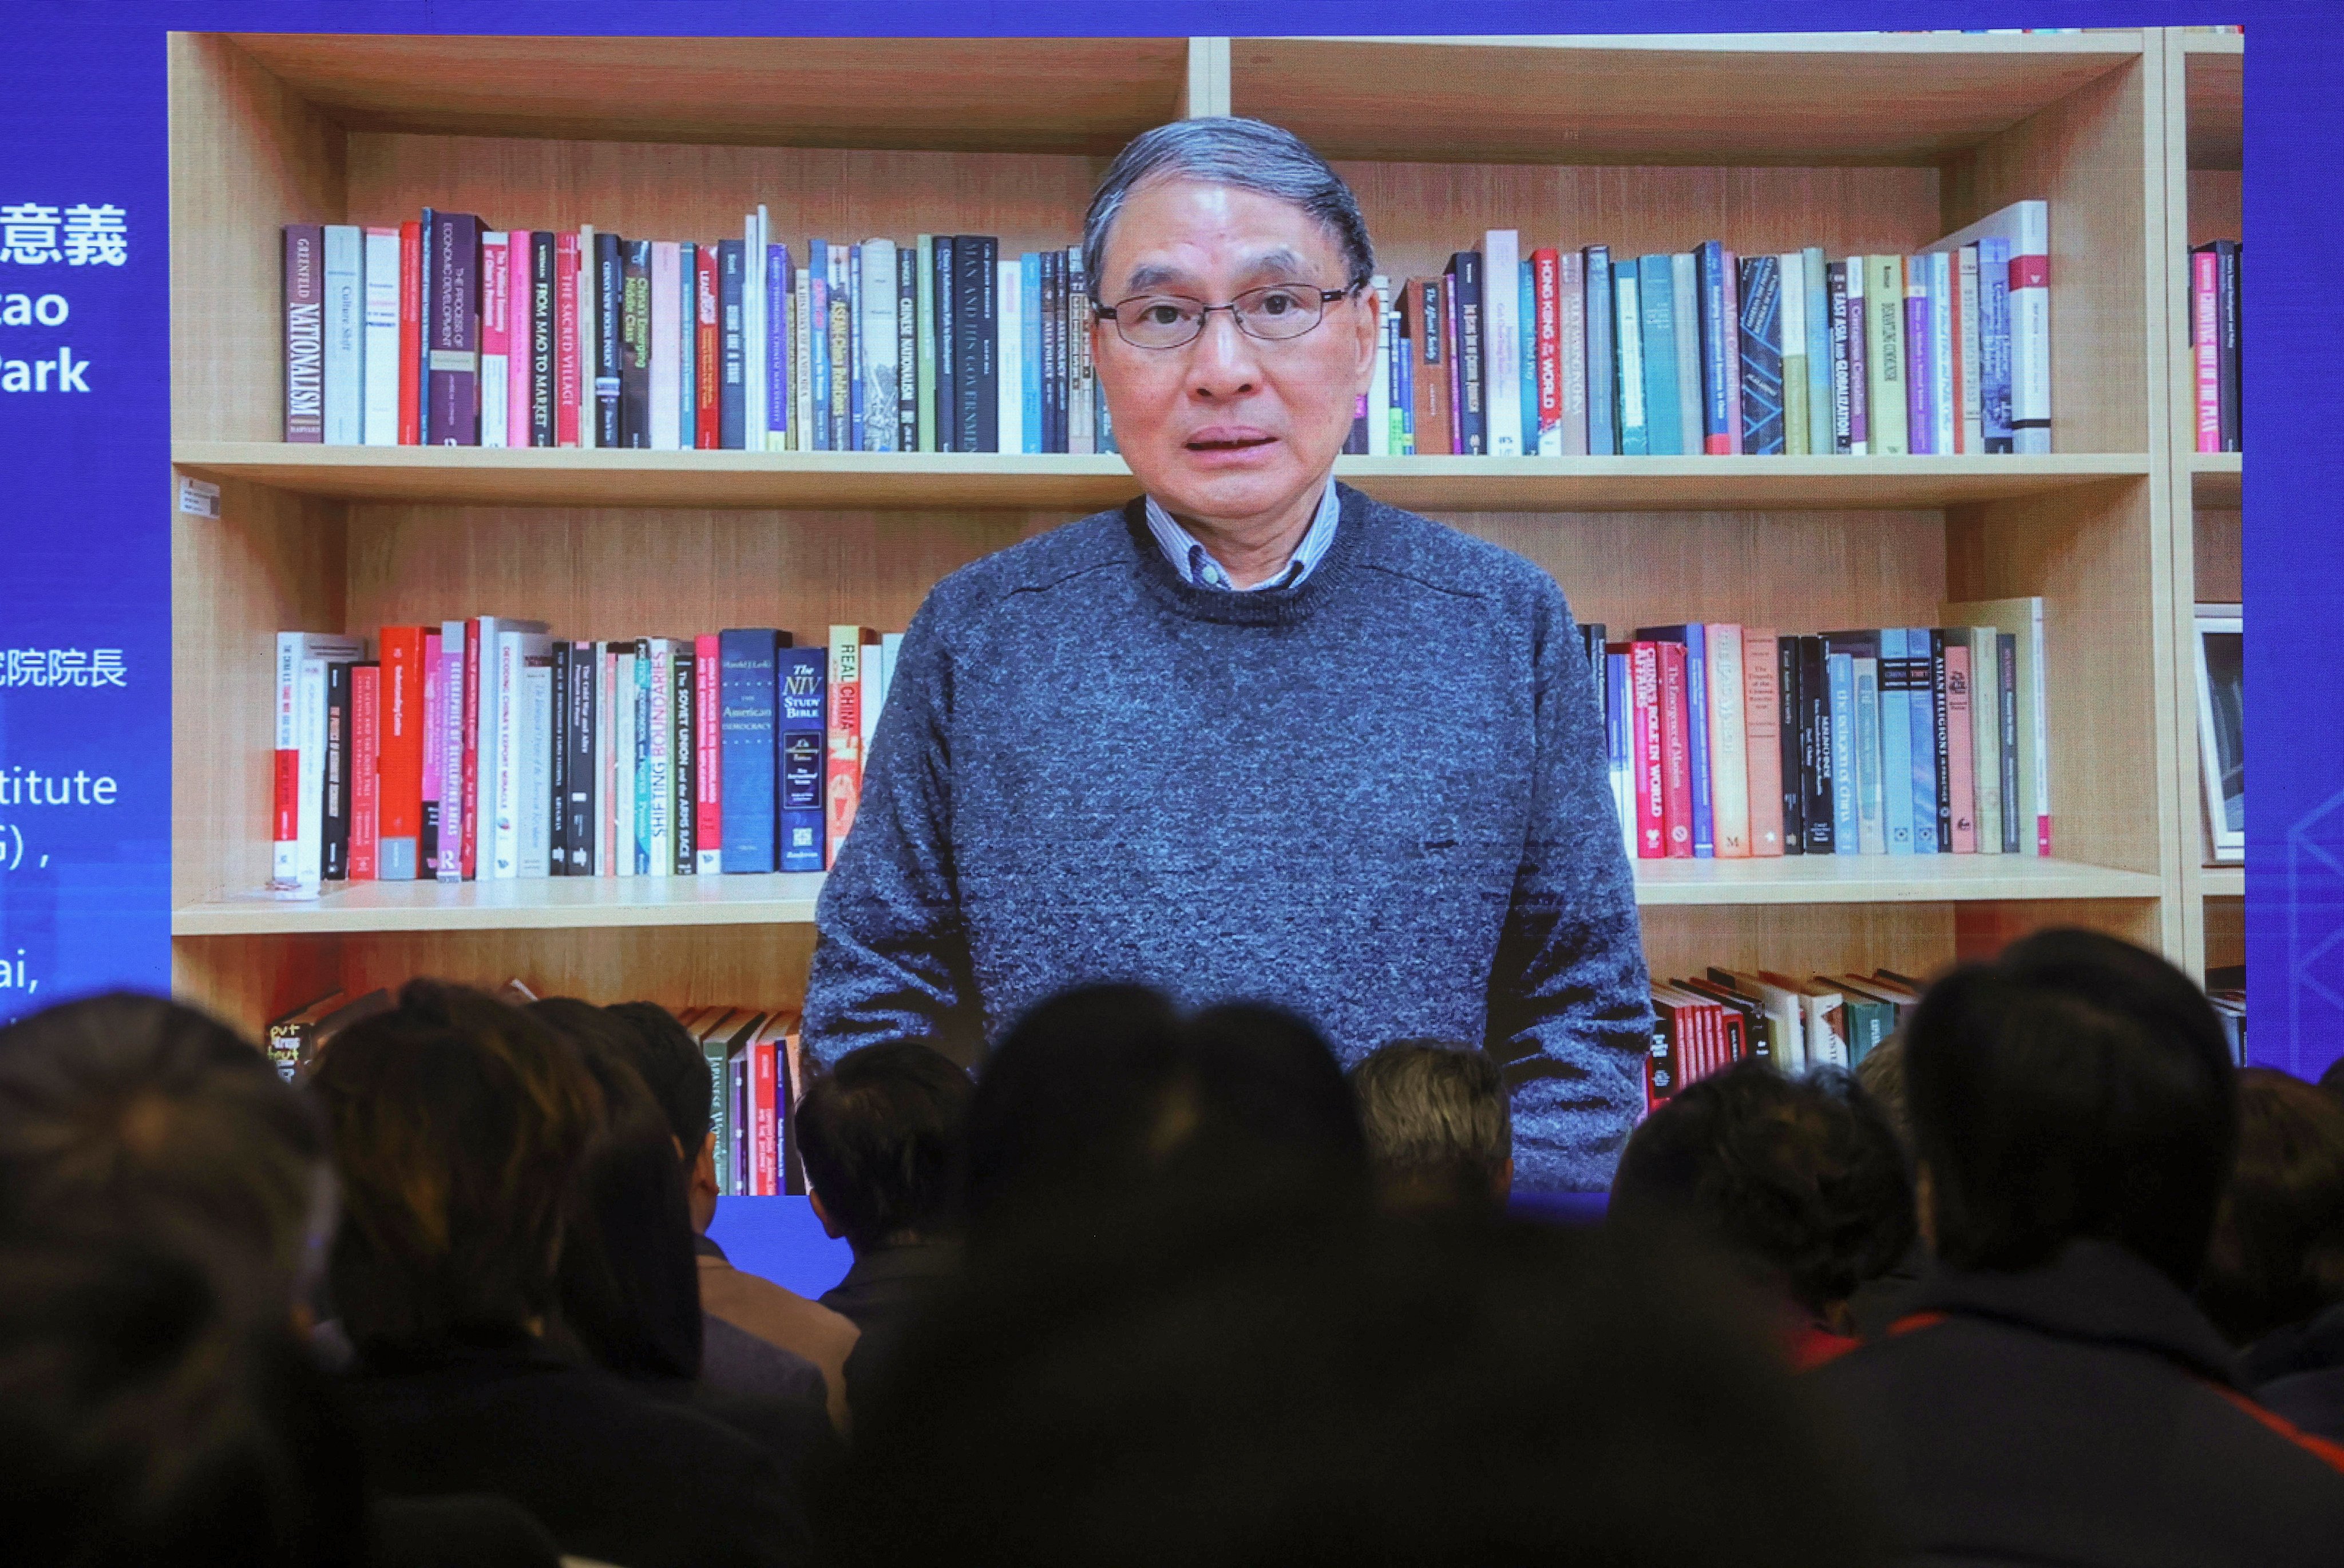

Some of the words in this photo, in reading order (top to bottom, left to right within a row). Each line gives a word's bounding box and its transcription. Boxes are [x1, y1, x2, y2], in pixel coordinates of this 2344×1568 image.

[0, 203, 127, 266] 意義
[441, 222, 452, 275] ECONOMIC
[296, 238, 310, 298] GREENFELD
[964, 243, 977, 278] MAN
[562, 275, 573, 298] THE
[625, 276, 636, 312] Middle
[1426, 287, 1437, 302] The
[1542, 260, 1553, 298] HONG
[0, 293, 69, 326] ao
[441, 276, 452, 347] DEVELOPMENT
[536, 283, 548, 316] FROM
[638, 277, 648, 315] China's
[964, 285, 977, 318] AND
[1834, 292, 1846, 317] EAST
[562, 302, 573, 353] SACRED
[625, 314, 635, 342] Class
[901, 297, 913, 336] CHINESE
[1045, 320, 1054, 343] ASIA
[1058, 320, 1066, 343] ASIA
[1424, 305, 1437, 333] Affluent
[1542, 301, 1554, 340] KONG
[1834, 318, 1847, 343] ASIA
[535, 320, 548, 351] MAO
[635, 318, 648, 369] Emerging
[964, 324, 977, 350] HIS
[1424, 335, 1437, 360] Society
[0, 346, 91, 393] ark
[289, 302, 320, 416] NATIONALISM
[535, 355, 548, 373] TO
[603, 339, 612, 368] POLICY
[901, 338, 913, 401] NATIONALISM
[1045, 344, 1054, 379] POLICY
[1058, 343, 1066, 378] POLICY
[562, 356, 573, 406] VILLAGE
[1543, 358, 1555, 409] WORLD
[532, 375, 548, 428] MARKET
[1835, 360, 1849, 436] GLOBALIZATION
[581, 665, 590, 680] The
[679, 671, 688, 687] The
[793, 665, 814, 675] The
[840, 644, 855, 681] REAL
[1634, 648, 1648, 708] AFFAIRS
[1646, 647, 1658, 703] CHINA'S
[1668, 666, 1678, 684] The
[1935, 656, 1946, 691] ASIAN
[581, 681, 590, 700] Cold
[699, 675, 707, 690] THE
[782, 676, 822, 696] NIV
[581, 701, 590, 716] War
[653, 651, 666, 757] BOUNDARIES
[679, 688, 690, 726] SOVIET
[723, 707, 771, 718] American
[784, 697, 820, 708] STUDY
[786, 708, 819, 718] BIBLE
[840, 686, 855, 731] CHINA
[1668, 686, 1680, 735] Emergence
[1783, 694, 1792, 724] Security
[1837, 690, 1849, 713] the
[581, 717, 589, 732] and
[1648, 706, 1660, 742] ROLE
[1936, 692, 1947, 755] RELIGIONS
[580, 734, 589, 753] After
[679, 728, 690, 765] UNION
[1649, 745, 1660, 761] IN
[1670, 737, 1680, 749] of
[1835, 715, 1849, 768] religion
[680, 767, 690, 782] and
[1672, 750, 1682, 789] Maoism
[1838, 770, 1850, 783] of
[653, 761, 666, 837] SHIFTING
[680, 784, 690, 797] the
[1650, 764, 1662, 818] WORLD
[1839, 785, 1851, 822] china
[680, 798, 691, 827] ARMS
[680, 830, 691, 858] RACE
